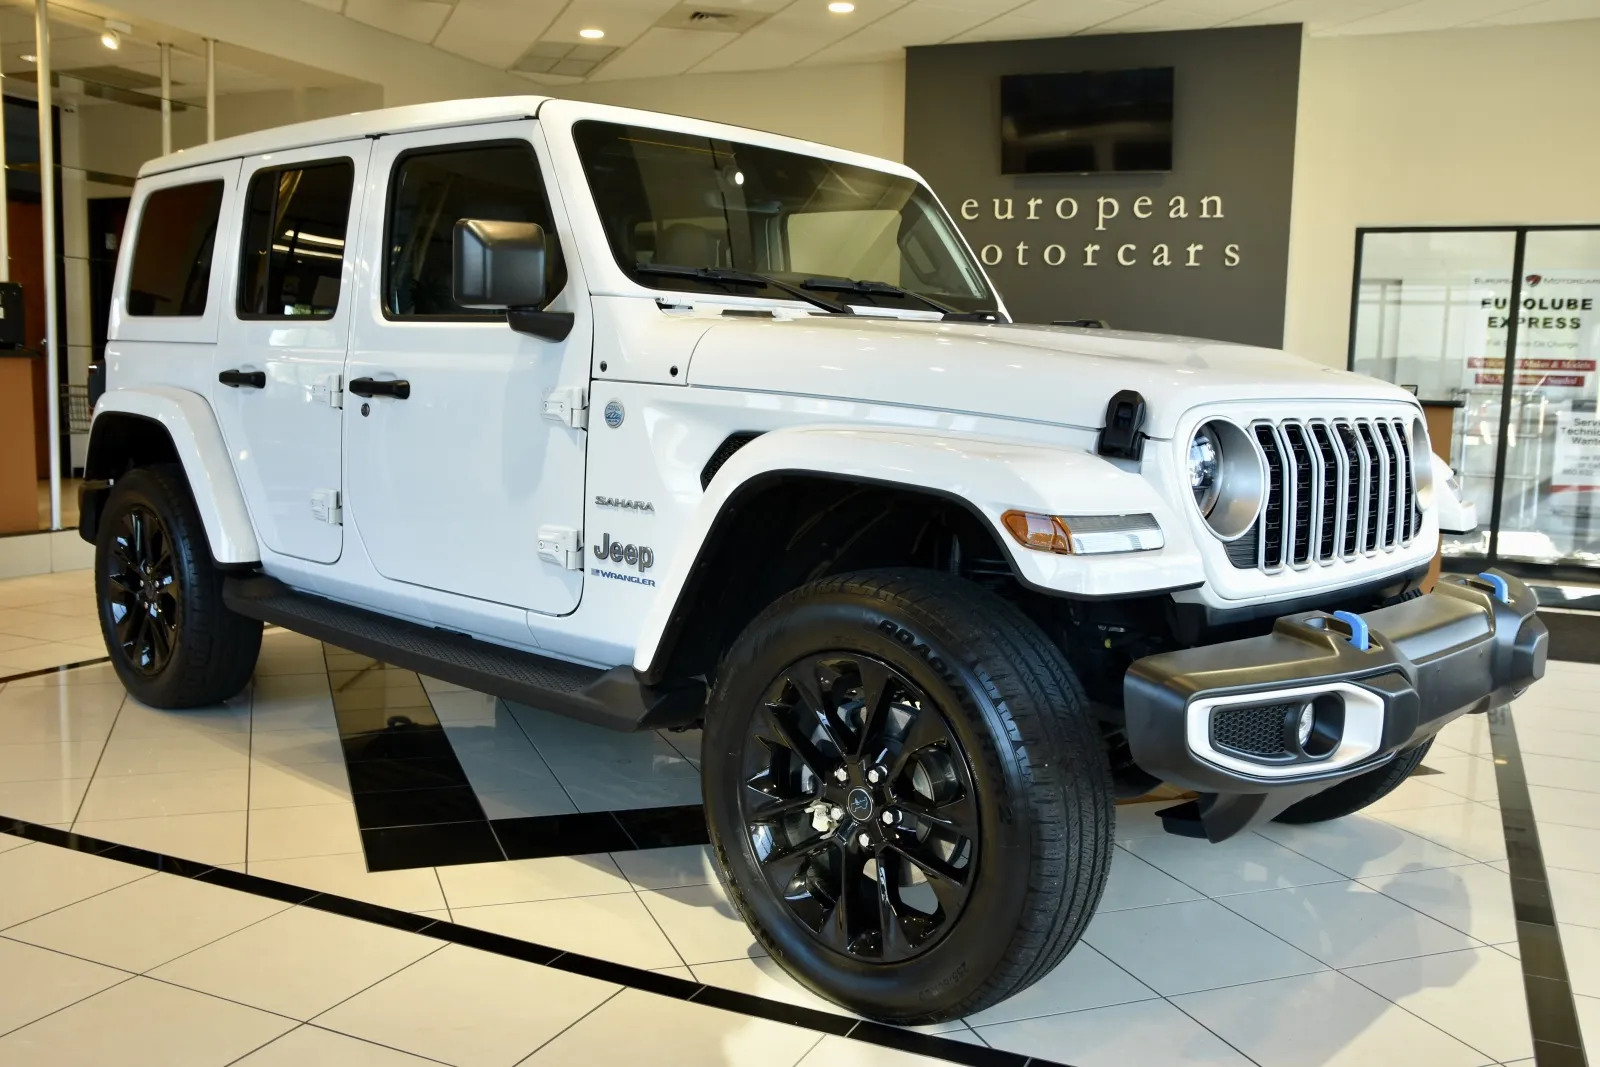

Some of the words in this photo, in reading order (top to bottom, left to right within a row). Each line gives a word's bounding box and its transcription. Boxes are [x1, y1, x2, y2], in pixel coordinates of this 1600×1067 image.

[961, 194, 1225, 231] european
[980, 240, 1241, 267] otorcars
[1481, 298, 1593, 311] EUOLUBE
[594, 495, 655, 512] SAHARA
[593, 532, 655, 573] Jeep
[600, 569, 656, 588] WRANGLER
